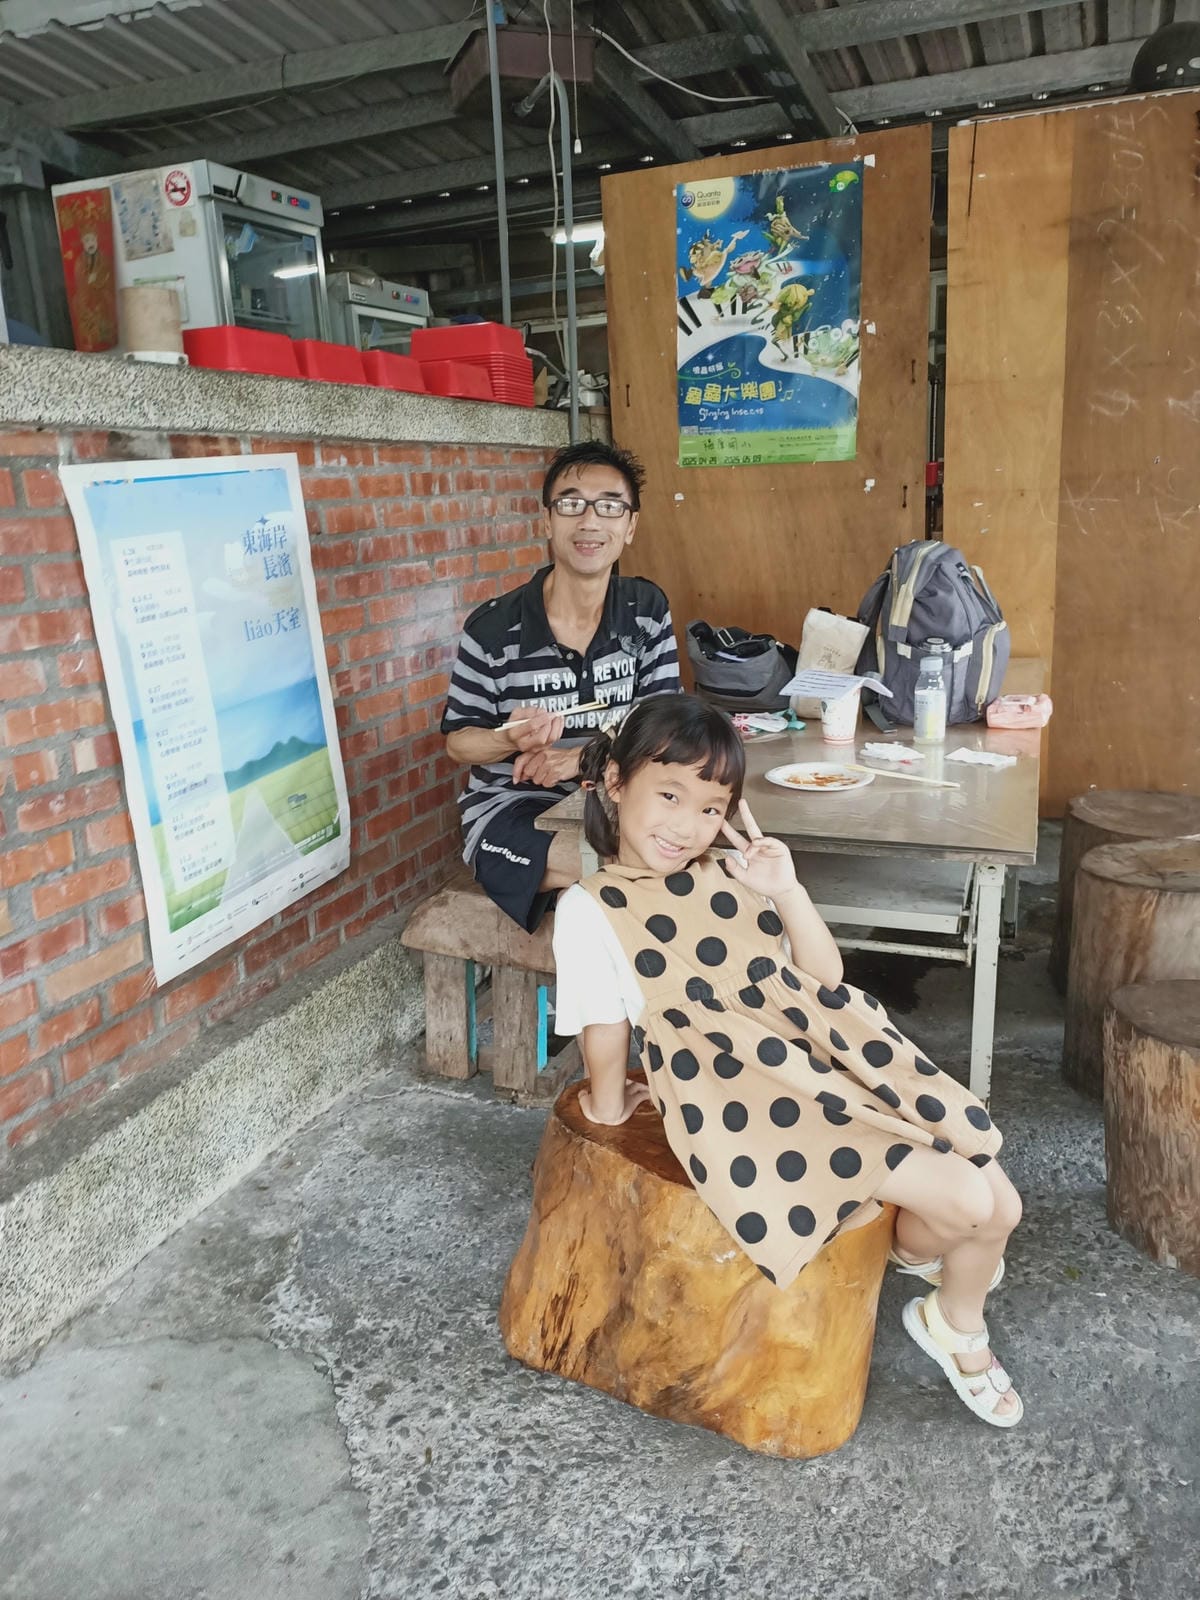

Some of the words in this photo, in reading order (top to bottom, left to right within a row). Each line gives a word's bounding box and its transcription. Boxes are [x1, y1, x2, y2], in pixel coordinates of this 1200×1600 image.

[698, 407, 730, 423] Singing
[731, 407, 765, 416] Insects
[242, 524, 288, 556] 東海岸
[263, 551, 293, 581] 長濱
[533, 672, 562, 692] IT'S
